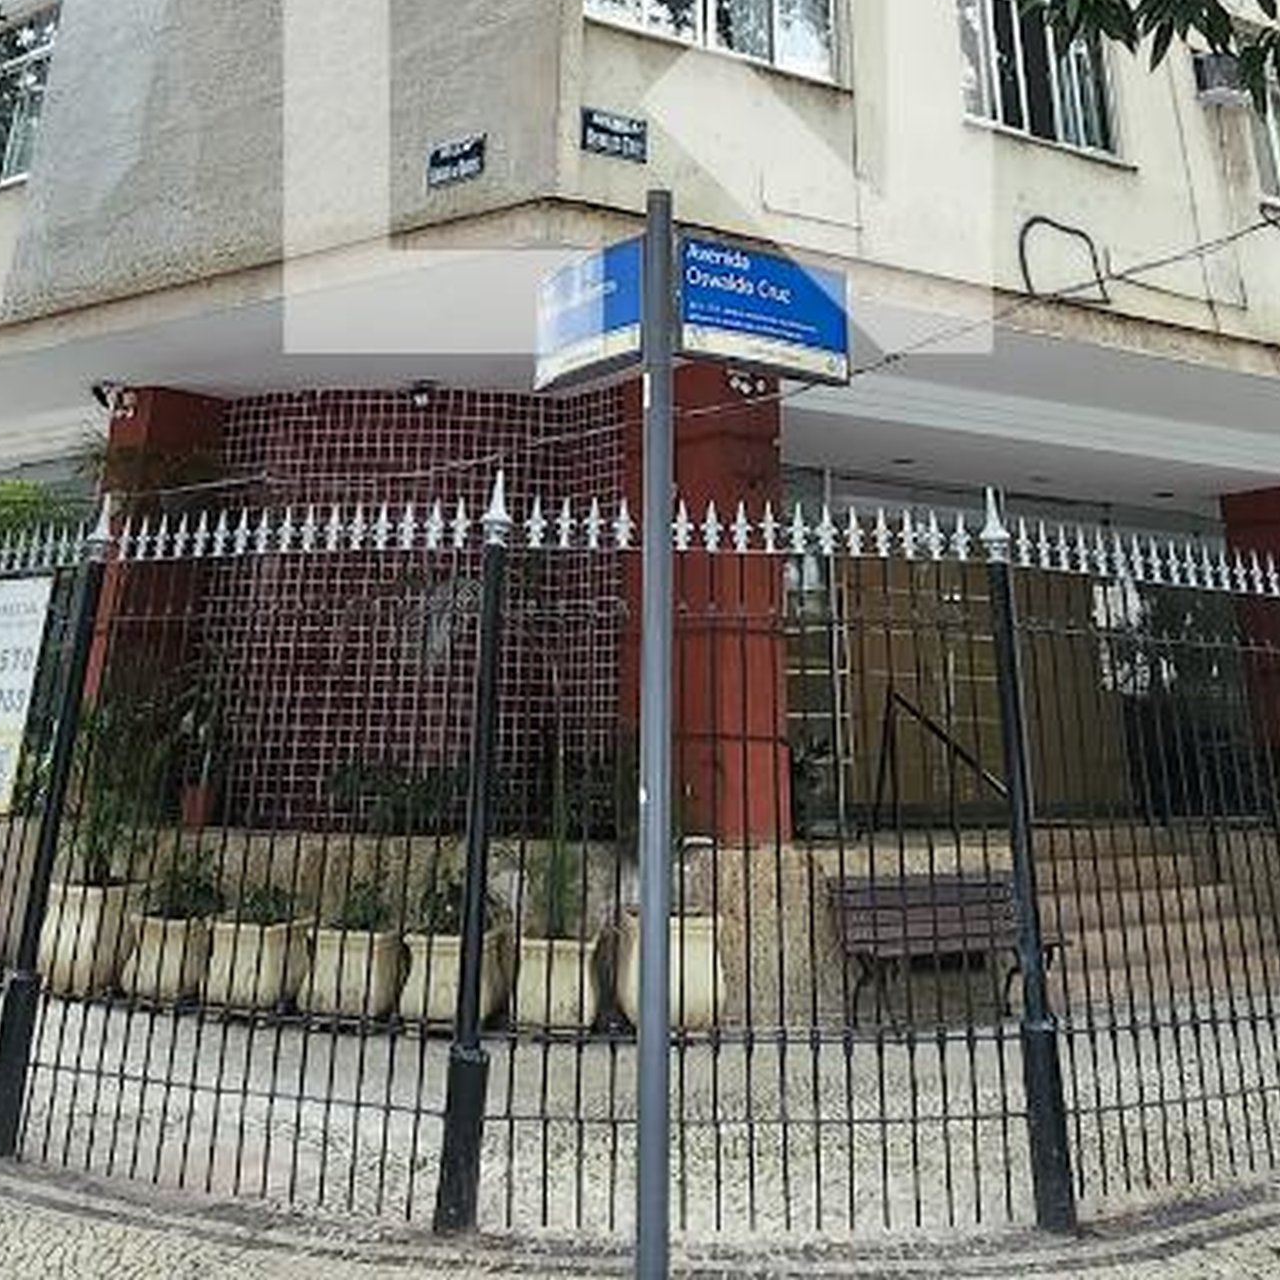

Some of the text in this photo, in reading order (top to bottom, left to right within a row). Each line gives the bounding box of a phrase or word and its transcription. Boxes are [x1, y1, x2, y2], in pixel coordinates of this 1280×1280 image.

[686, 243, 750, 270] Avenida
[686, 266, 792, 305] Oswaldo Cruz
